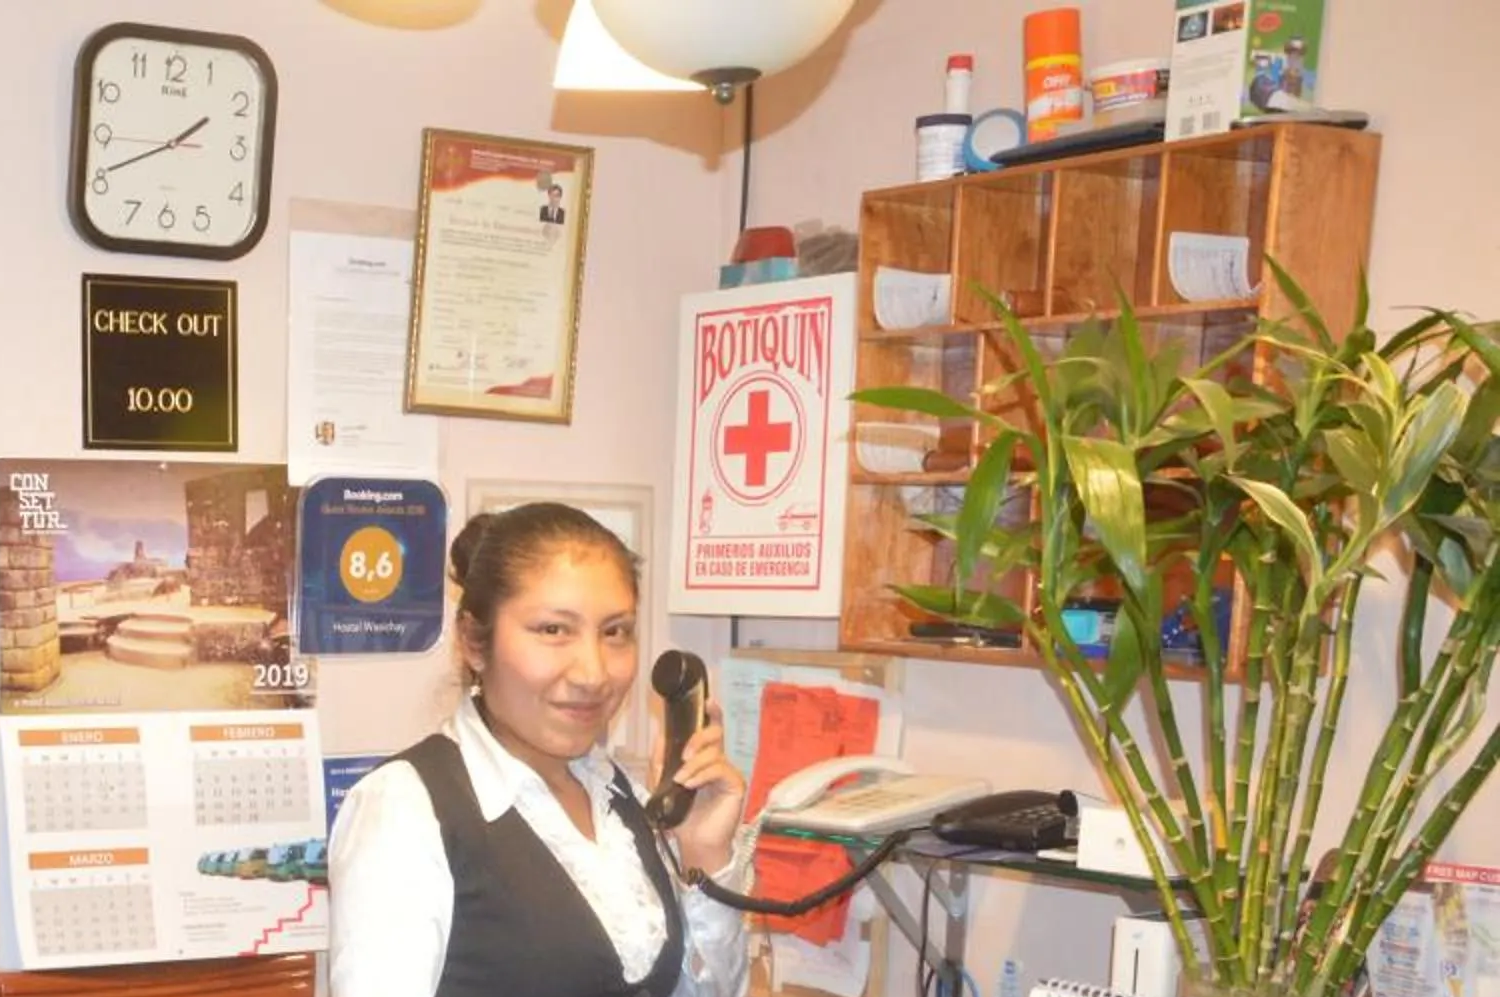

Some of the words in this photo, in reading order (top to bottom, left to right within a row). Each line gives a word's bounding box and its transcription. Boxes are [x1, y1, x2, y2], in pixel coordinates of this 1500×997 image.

[132, 52, 147, 78] 11
[165, 55, 187, 83] 12
[206, 60, 213, 85] 1
[98, 79, 121, 104] 10
[231, 91, 249, 118] 2
[94, 123, 113, 150] 9
[229, 135, 247, 162] 3
[92, 168, 109, 195] 8
[228, 182, 244, 206] 4
[124, 200, 142, 226] 7
[158, 204, 176, 229] 6
[192, 205, 211, 232] 5
[94, 308, 169, 335] CHECK
[177, 312, 222, 338] OUT
[699, 309, 825, 407] BOTIQUIN
[127, 386, 194, 413] 10.00
[10, 473, 49, 491] CON
[19, 490, 55, 510] SET
[343, 489, 404, 503] Booking.com
[696, 543, 755, 559] PRIMEROS
[758, 542, 812, 558] AUXILIOS
[349, 551, 394, 583] 8,6
[253, 663, 310, 688] 2019
[68, 853, 115, 868] MARZO
